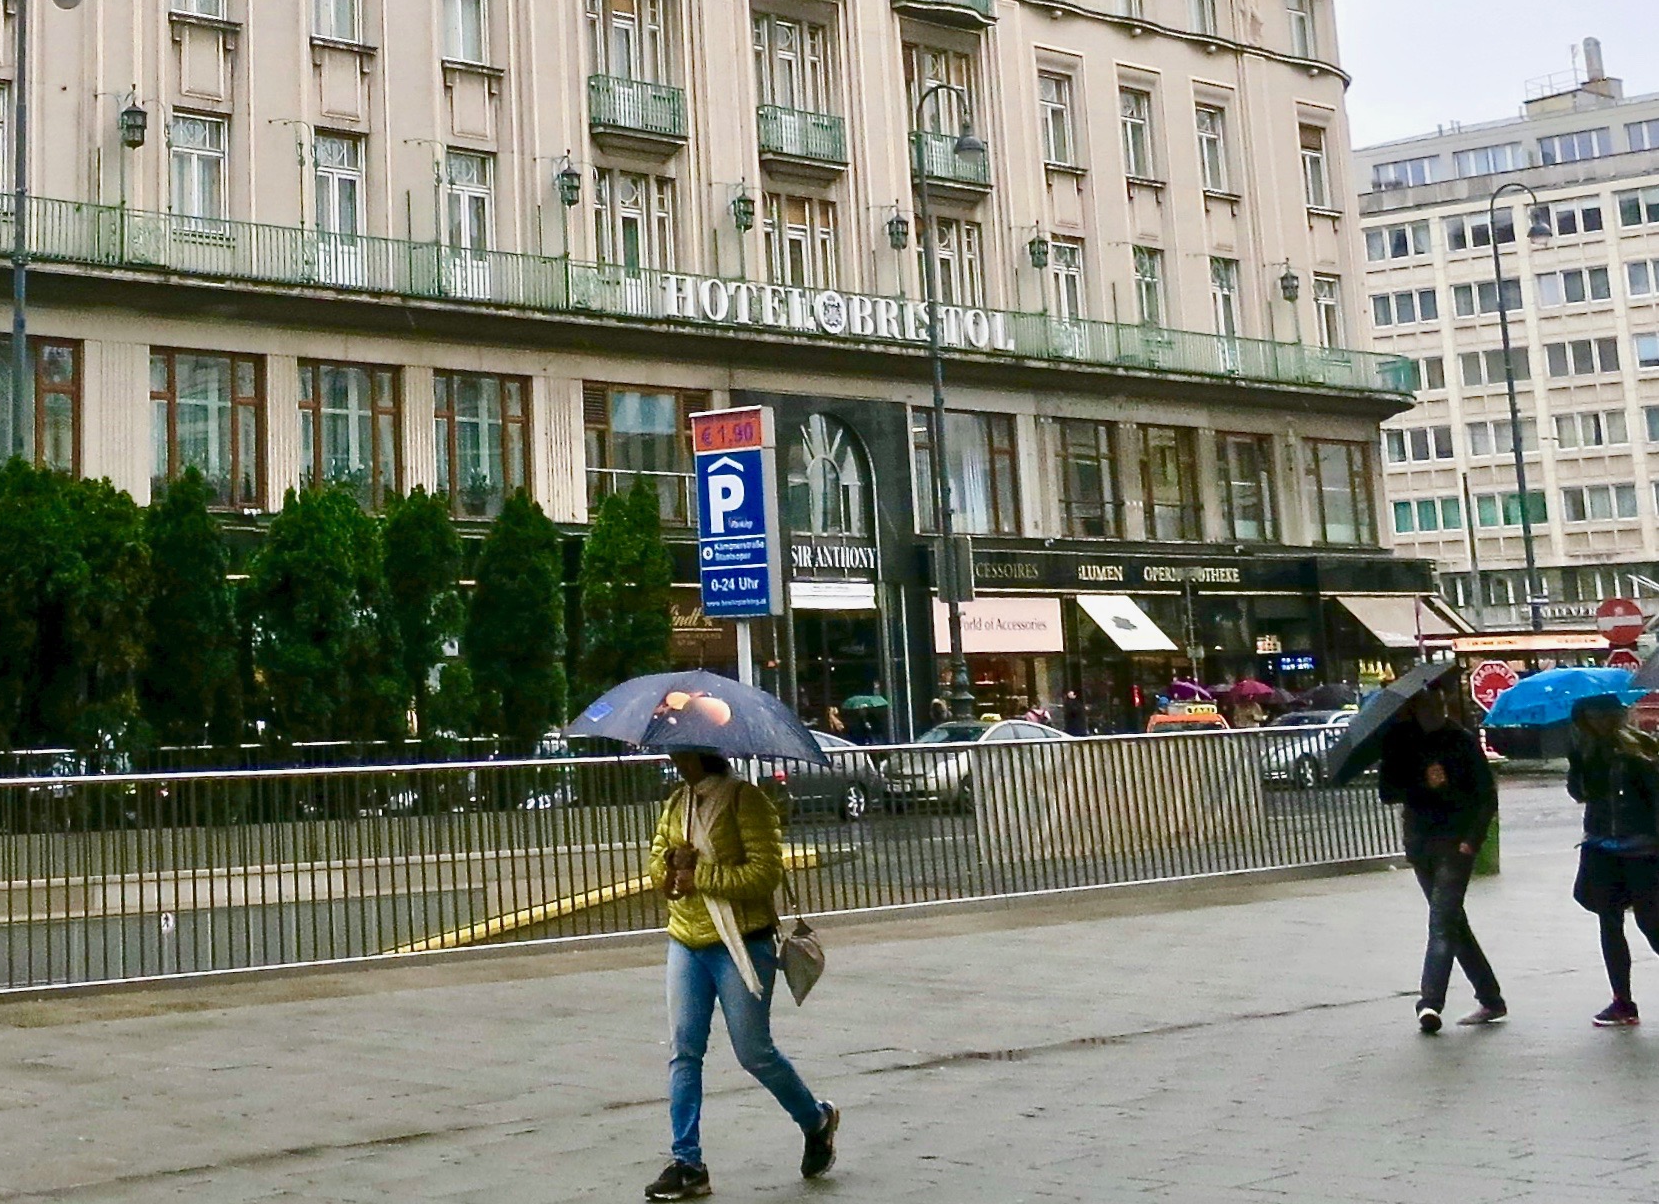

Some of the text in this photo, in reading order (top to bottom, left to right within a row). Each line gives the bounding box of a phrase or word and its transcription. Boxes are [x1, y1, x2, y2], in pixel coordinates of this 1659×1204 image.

[661, 274, 1015, 350] HOTEL BRISTOL
[708, 474, 745, 533] P
[791, 545, 876, 569] SIR ANTHONY
[975, 562, 1038, 578] CESSOIRES
[711, 577, 759, 592] 0-24 Uhr
[963, 617, 982, 631] orld
[996, 618, 1047, 631] Accessories
